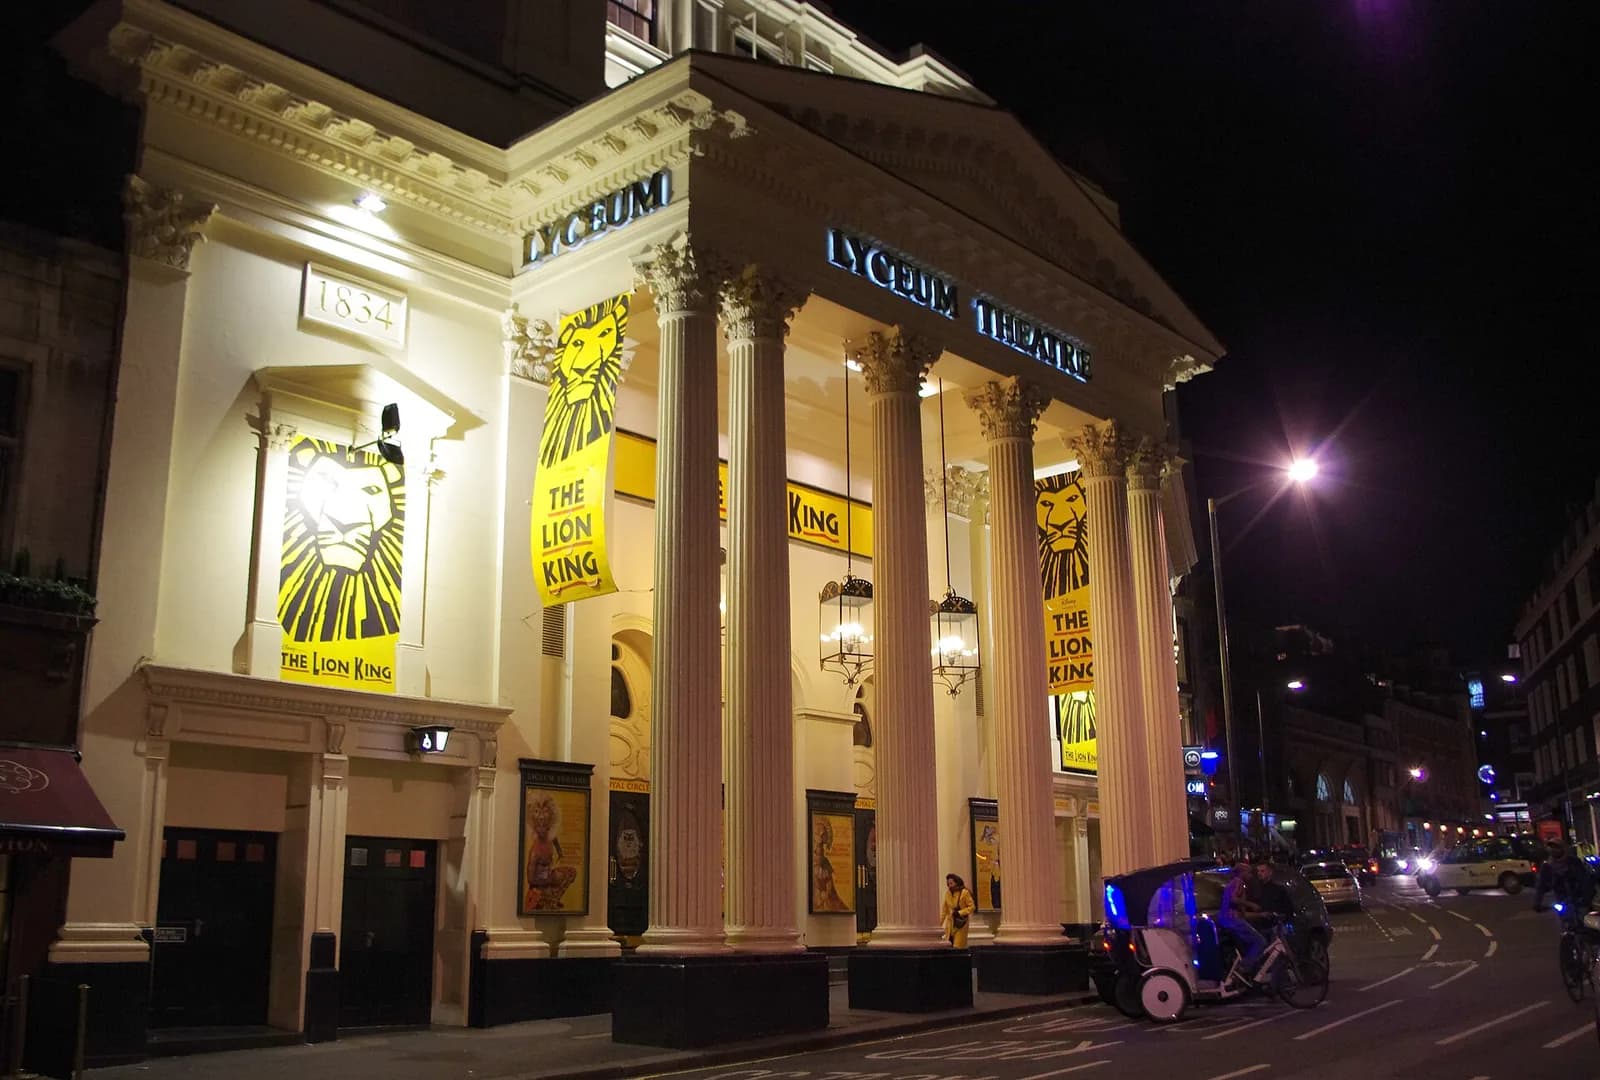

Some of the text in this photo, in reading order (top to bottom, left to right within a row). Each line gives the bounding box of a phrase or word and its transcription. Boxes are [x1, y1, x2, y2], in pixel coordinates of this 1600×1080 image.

[521, 168, 672, 268] LYCEUM
[321, 281, 393, 331] 1834
[826, 227, 1092, 382] LYCEUM THEATRE
[549, 479, 584, 510] THE
[542, 513, 592, 549] LION
[789, 491, 839, 536] KING
[542, 551, 599, 587] KING
[1052, 609, 1088, 631] THE
[281, 651, 391, 680] THE LION KING
